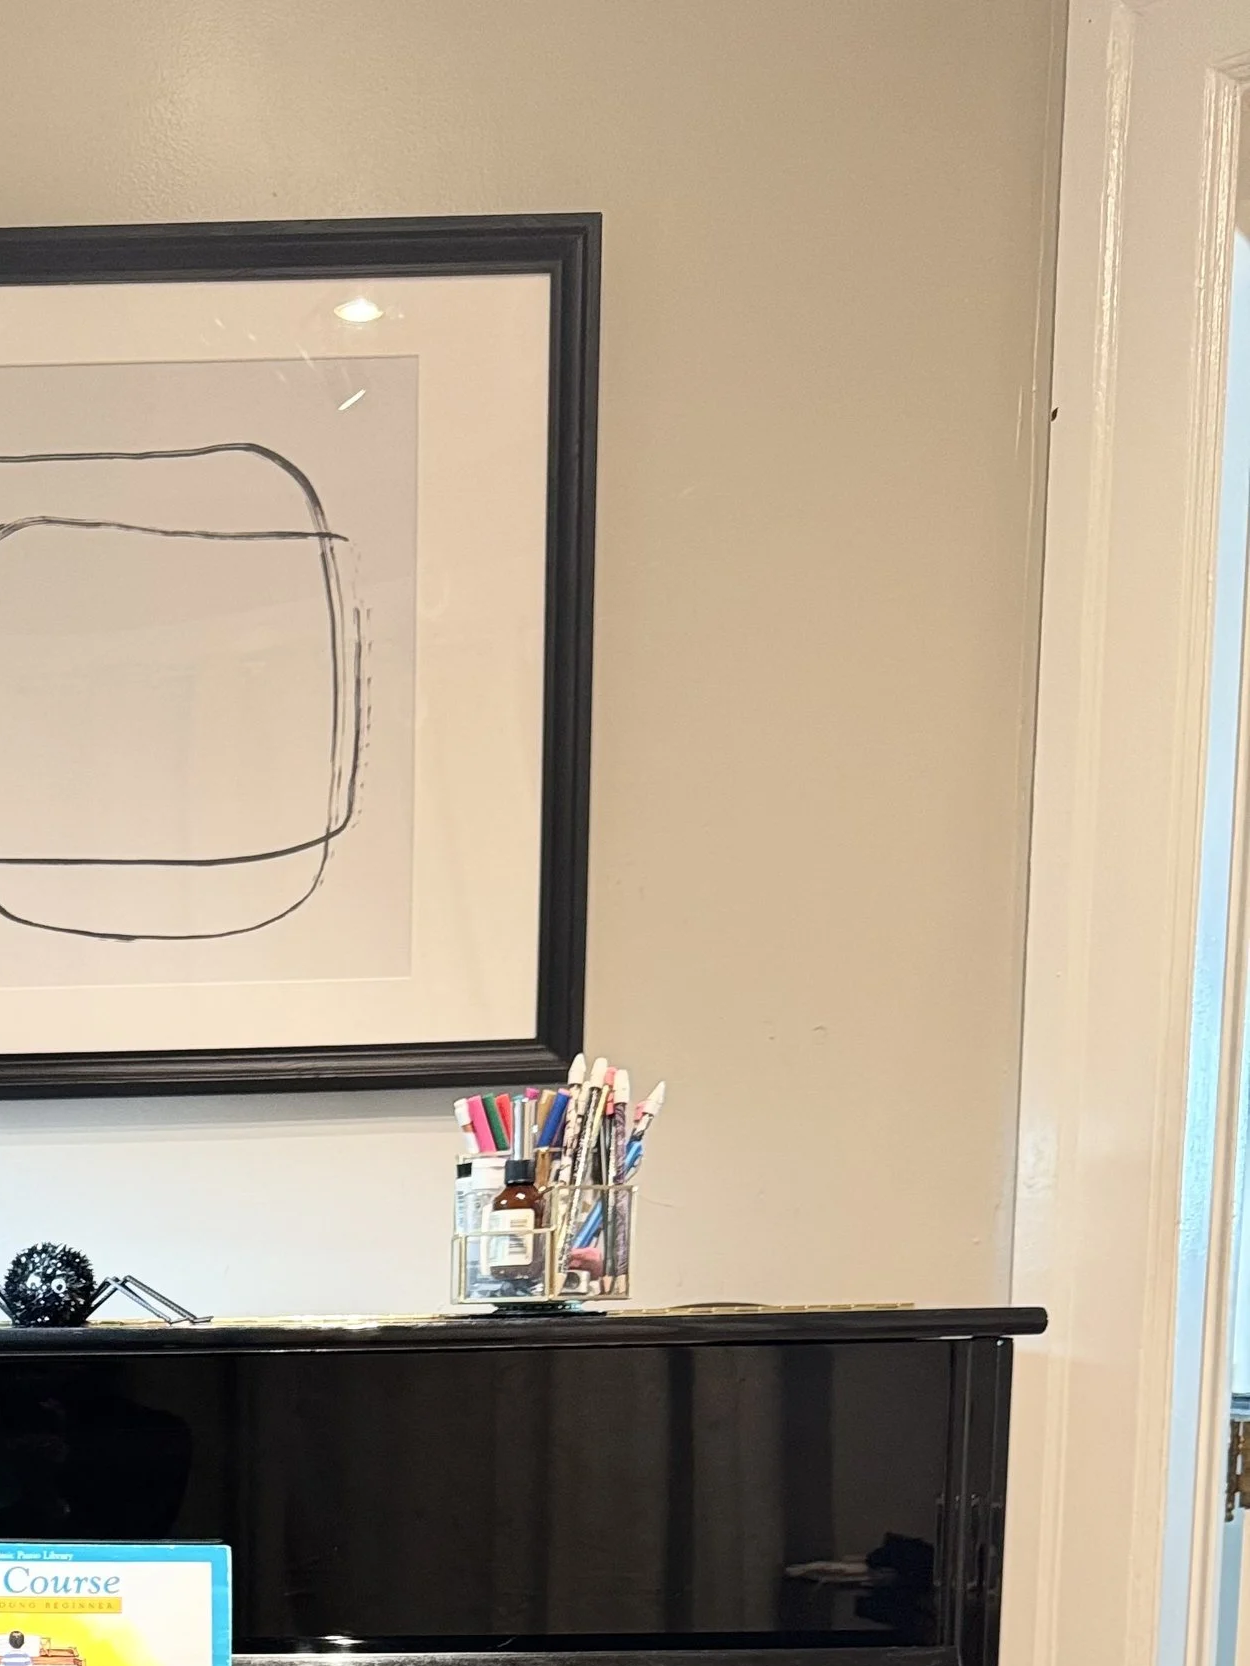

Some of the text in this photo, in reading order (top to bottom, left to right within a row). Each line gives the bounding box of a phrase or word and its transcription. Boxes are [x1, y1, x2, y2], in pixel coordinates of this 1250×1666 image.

[43, 1550, 74, 1561] Library
[3, 1566, 120, 1595] Course
[45, 1601, 115, 1610] BEGINNER
